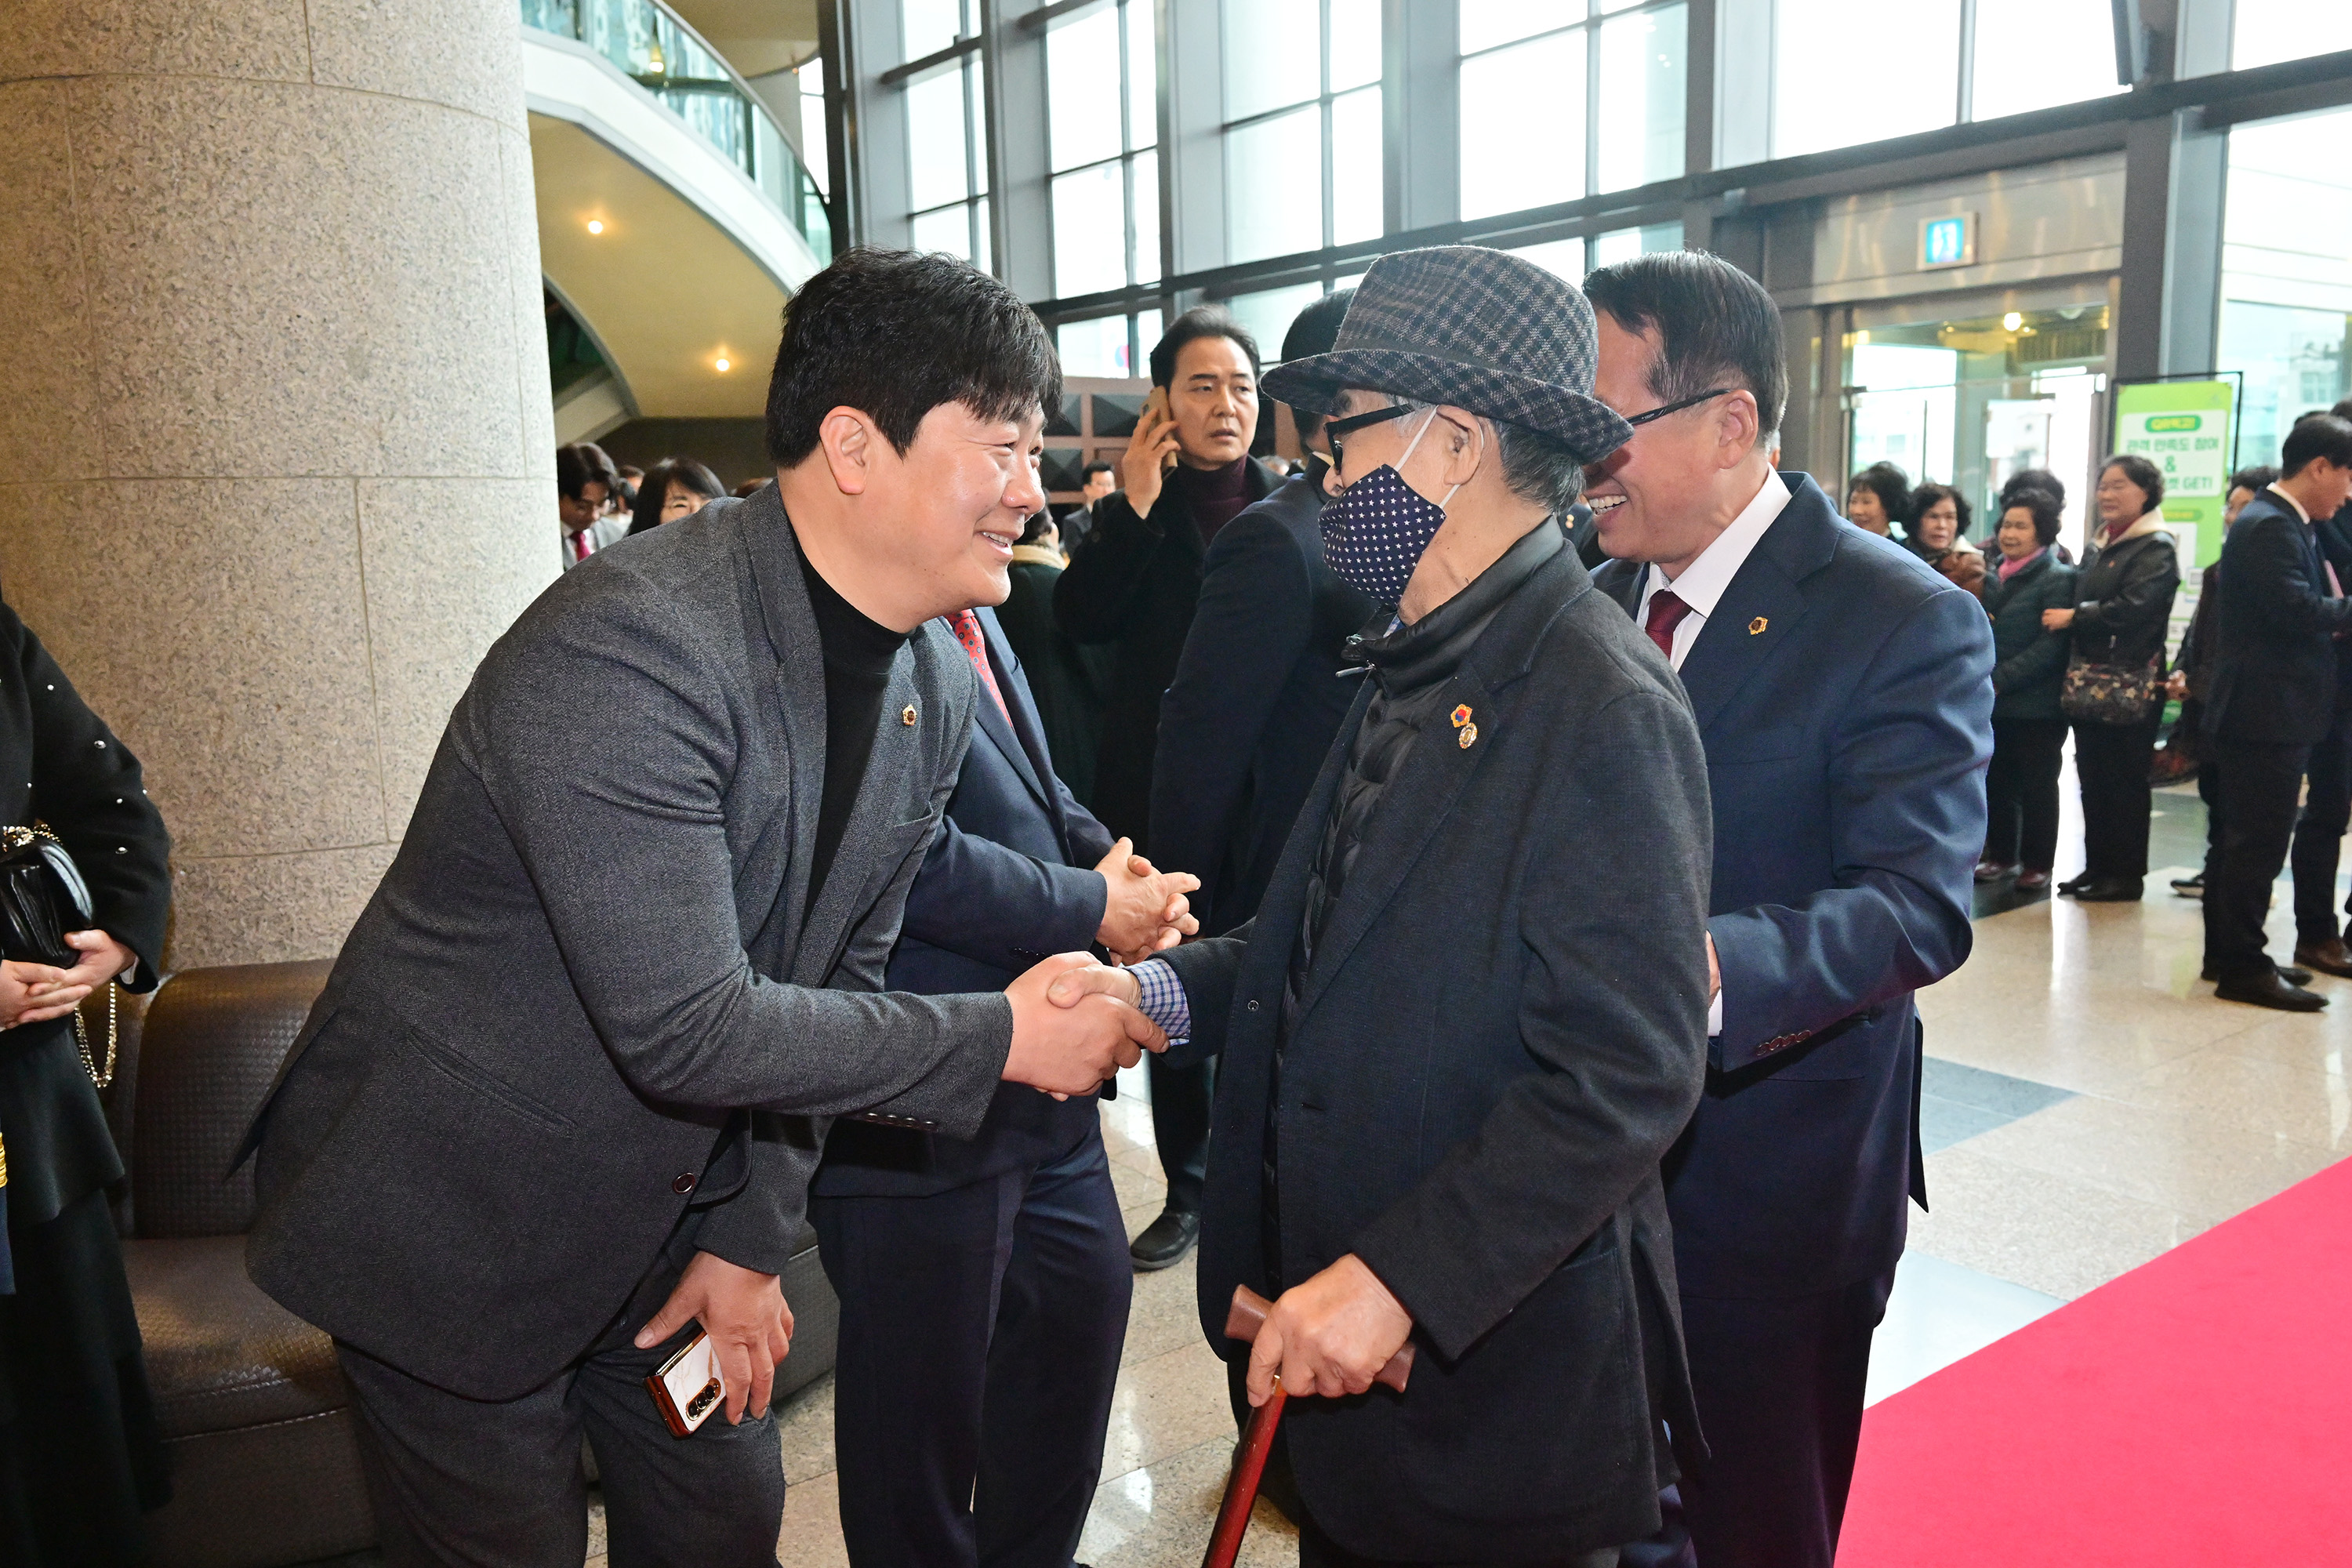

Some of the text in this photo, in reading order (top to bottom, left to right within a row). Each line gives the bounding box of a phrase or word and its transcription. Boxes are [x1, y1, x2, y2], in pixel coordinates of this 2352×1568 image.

[2154, 438, 2190, 452] 만족도
[2195, 437, 2219, 451] 참여
[2165, 456, 2176, 472] &
[2183, 477, 2212, 489] GET!
